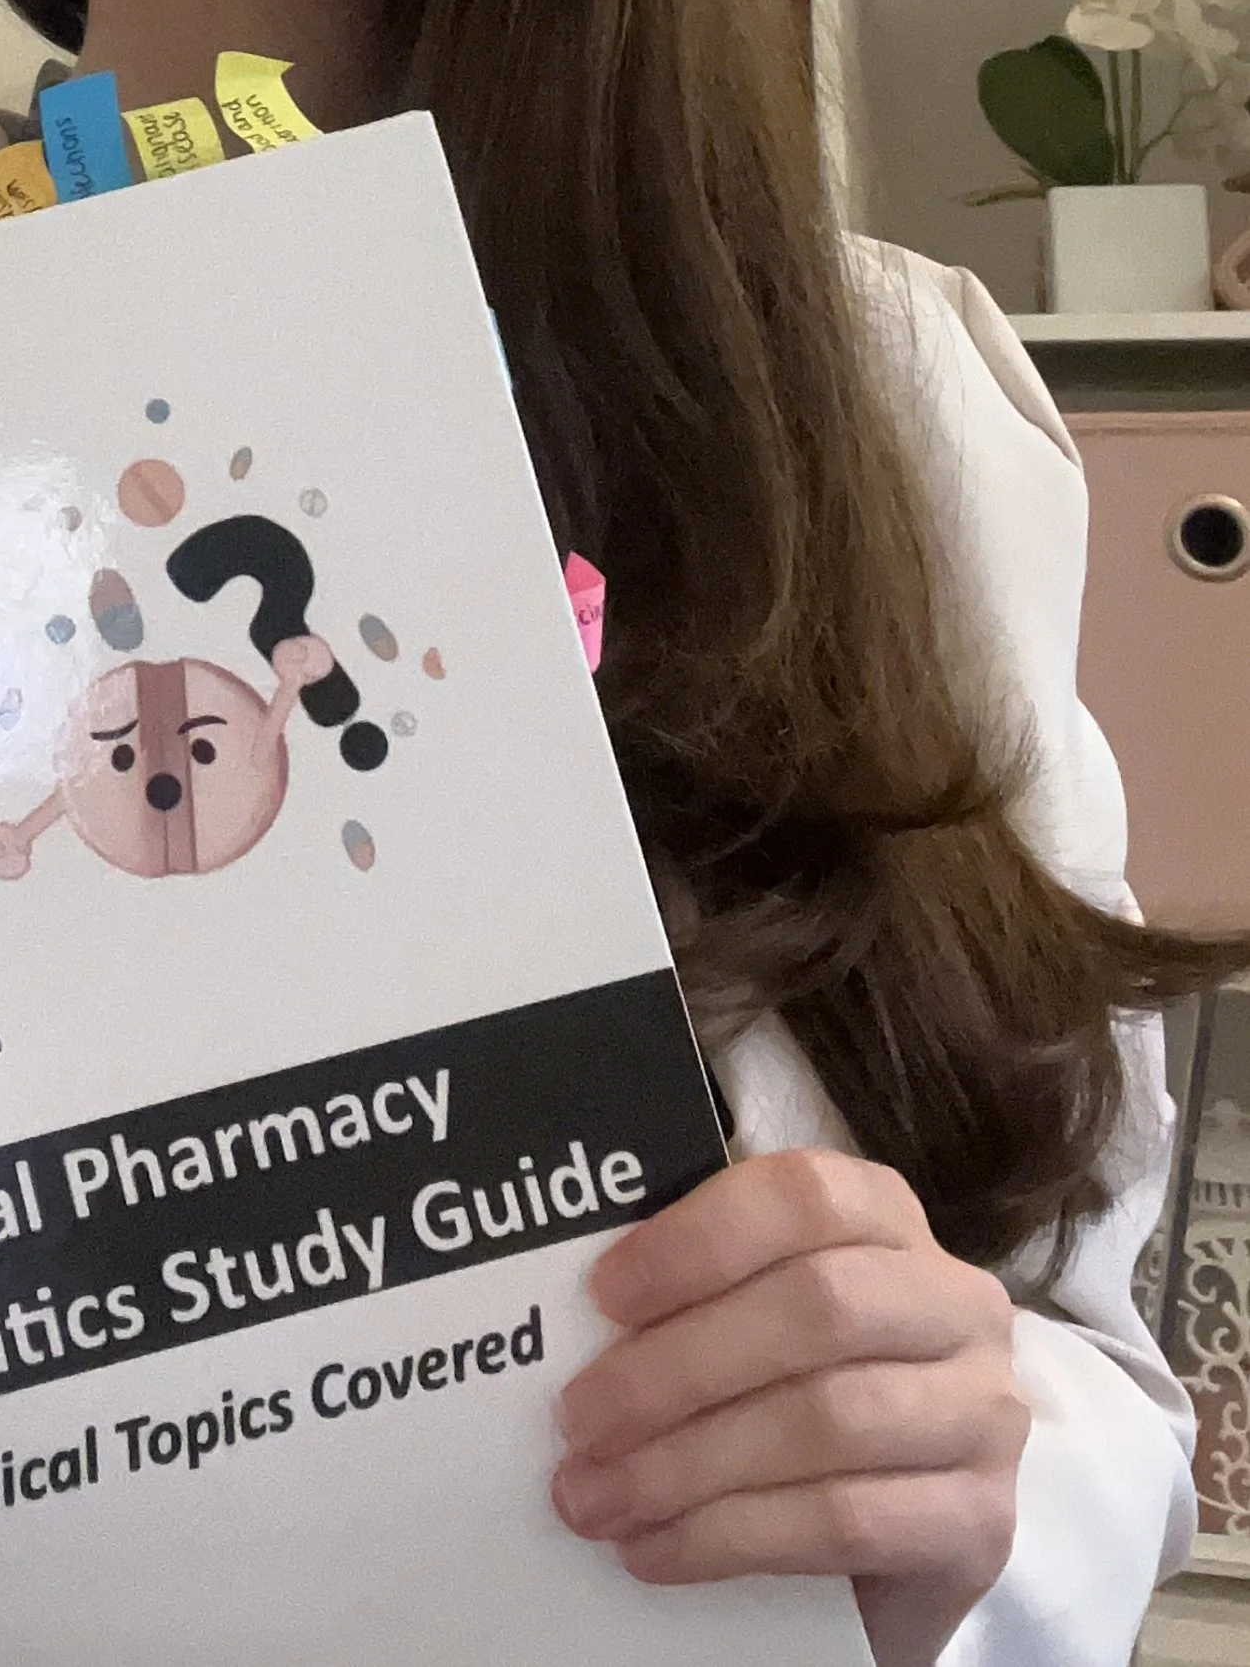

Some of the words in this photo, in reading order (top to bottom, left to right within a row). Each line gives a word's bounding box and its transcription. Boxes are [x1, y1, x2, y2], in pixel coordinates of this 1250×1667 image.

[221, 98, 252, 133] and
[63, 1068, 451, 1220] Pharmacy
[162, 1208, 387, 1324] Study
[411, 1141, 647, 1253] Guide
[114, 1390, 294, 1472] Topics
[310, 1306, 544, 1419] Covered
